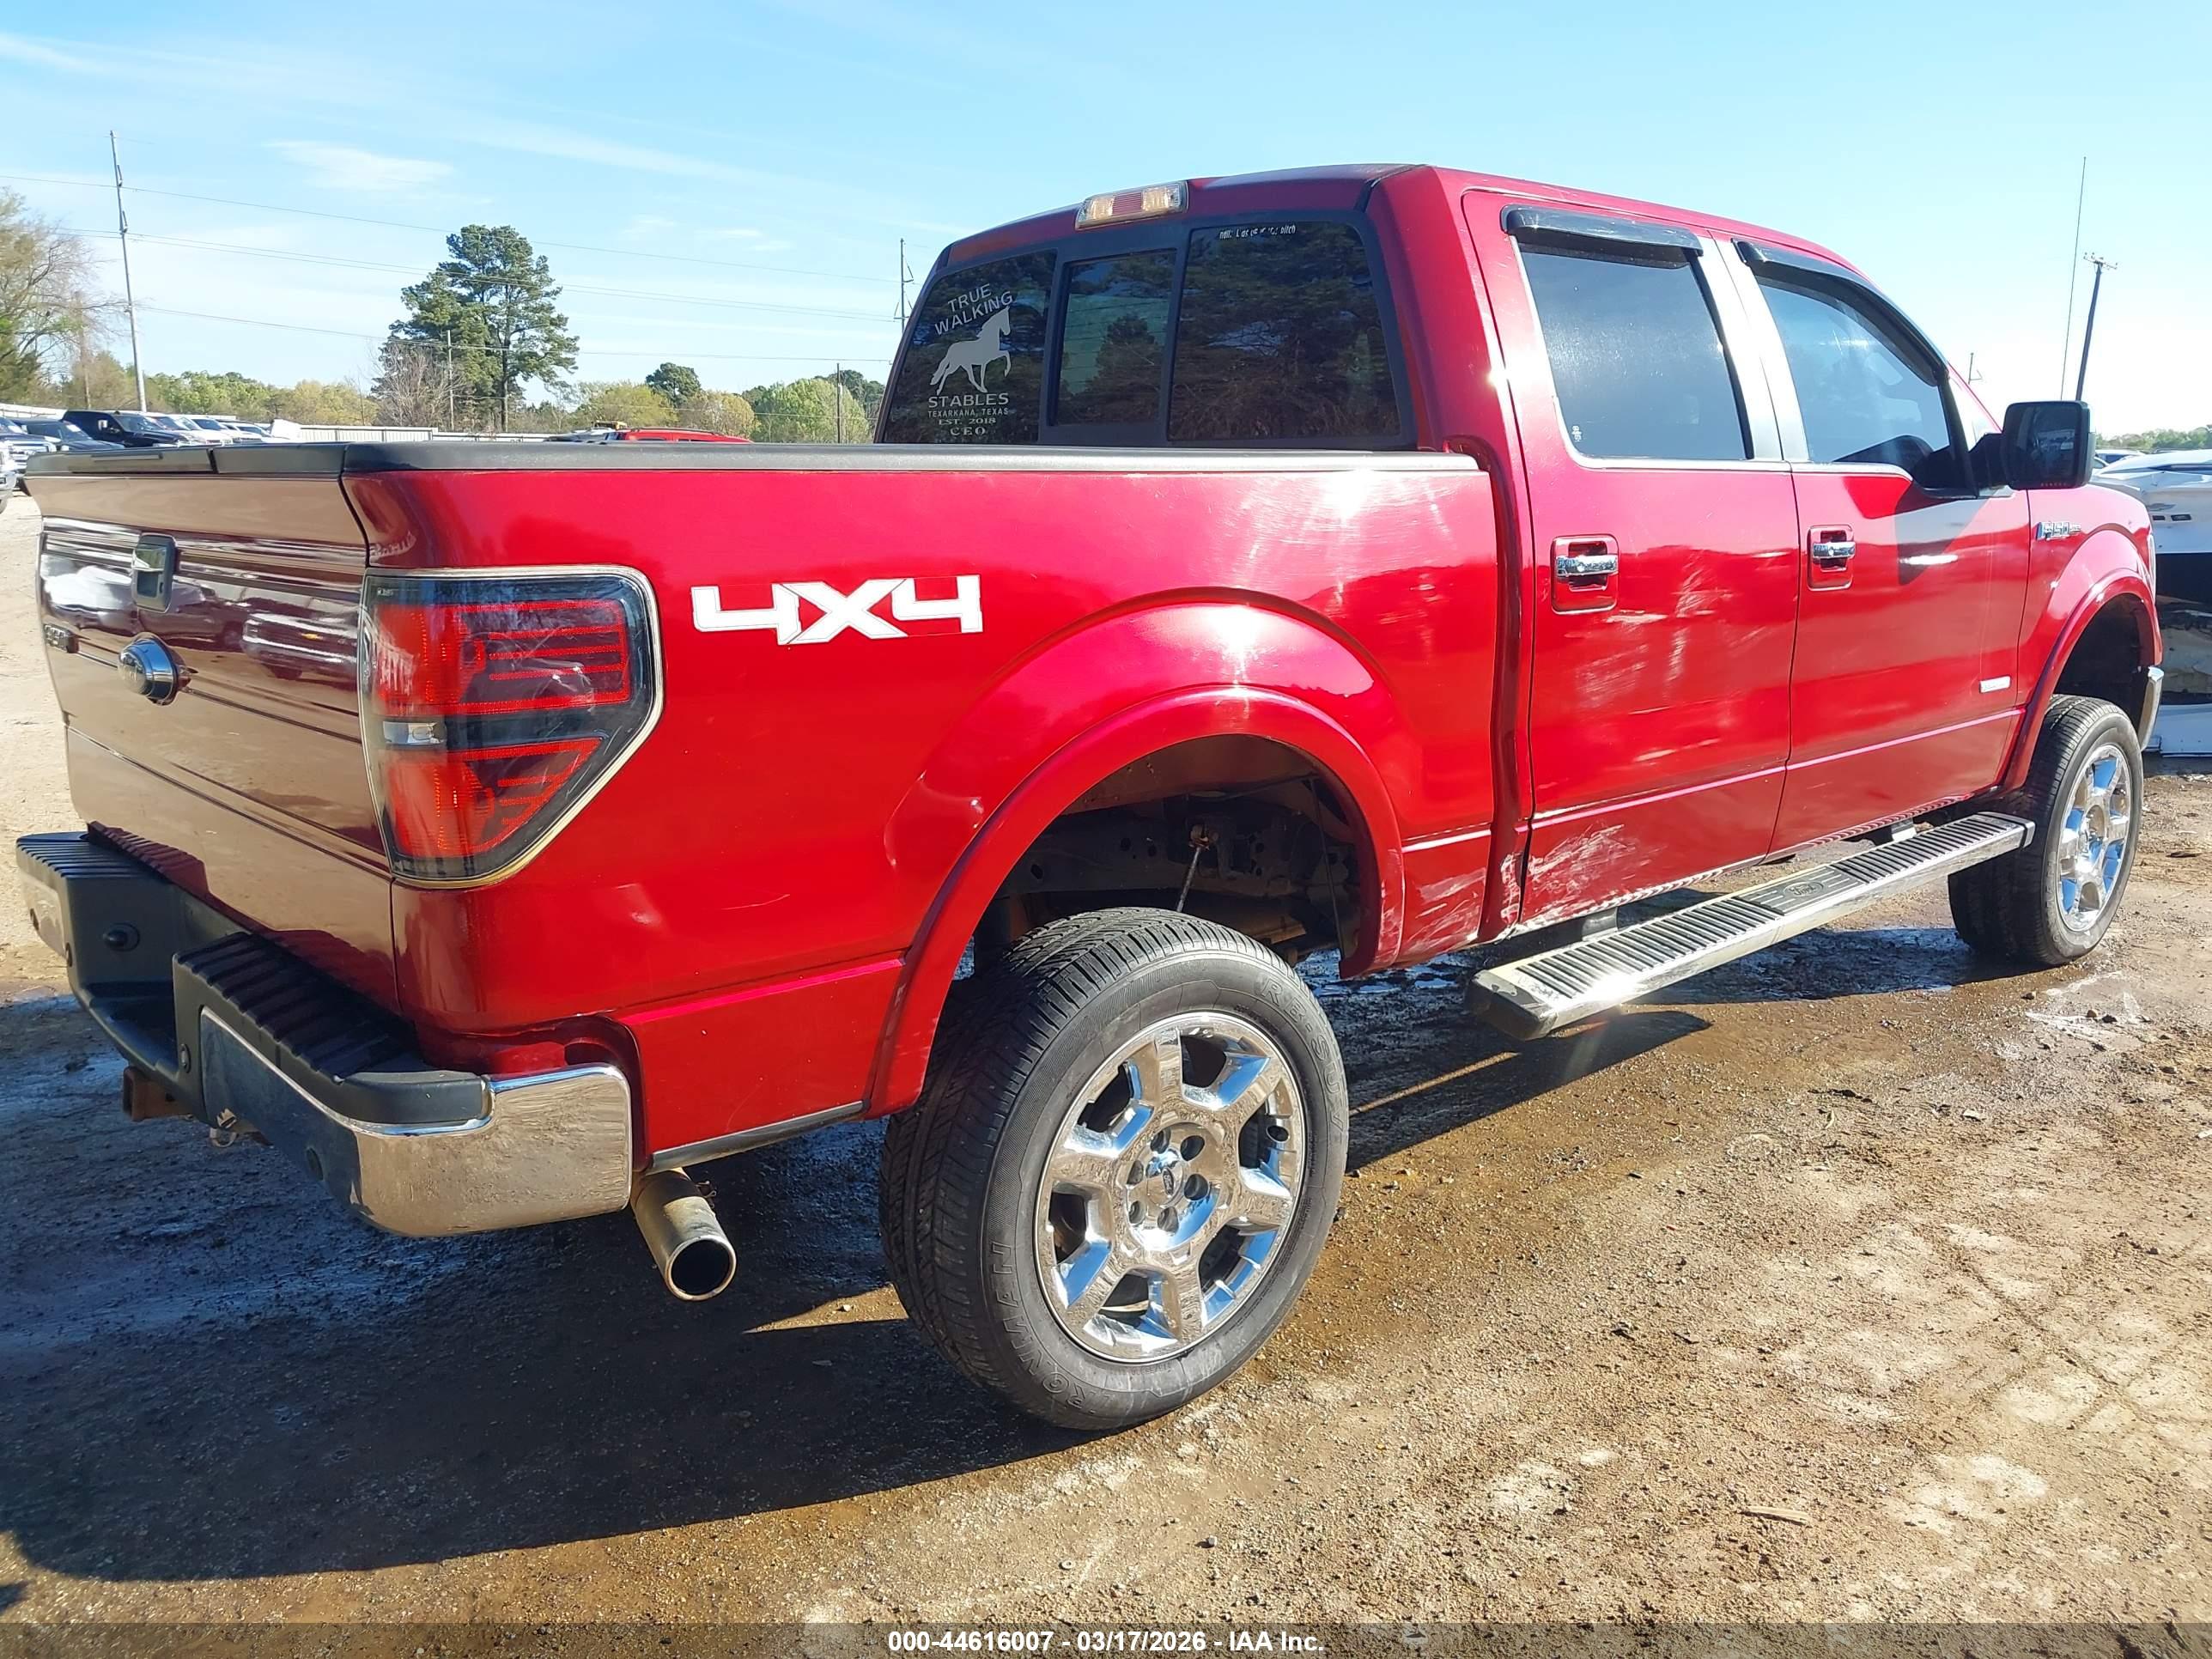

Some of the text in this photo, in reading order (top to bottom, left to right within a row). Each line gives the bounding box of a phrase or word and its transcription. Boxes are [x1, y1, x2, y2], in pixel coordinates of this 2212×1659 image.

[948, 283, 992, 312] TRUE
[935, 291, 1013, 336] WALKING
[928, 392, 1009, 408] STABLES
[928, 407, 1009, 418] TEXARKANA, TEXAS
[950, 426, 986, 436] CEO
[690, 574, 983, 646] 4X4
